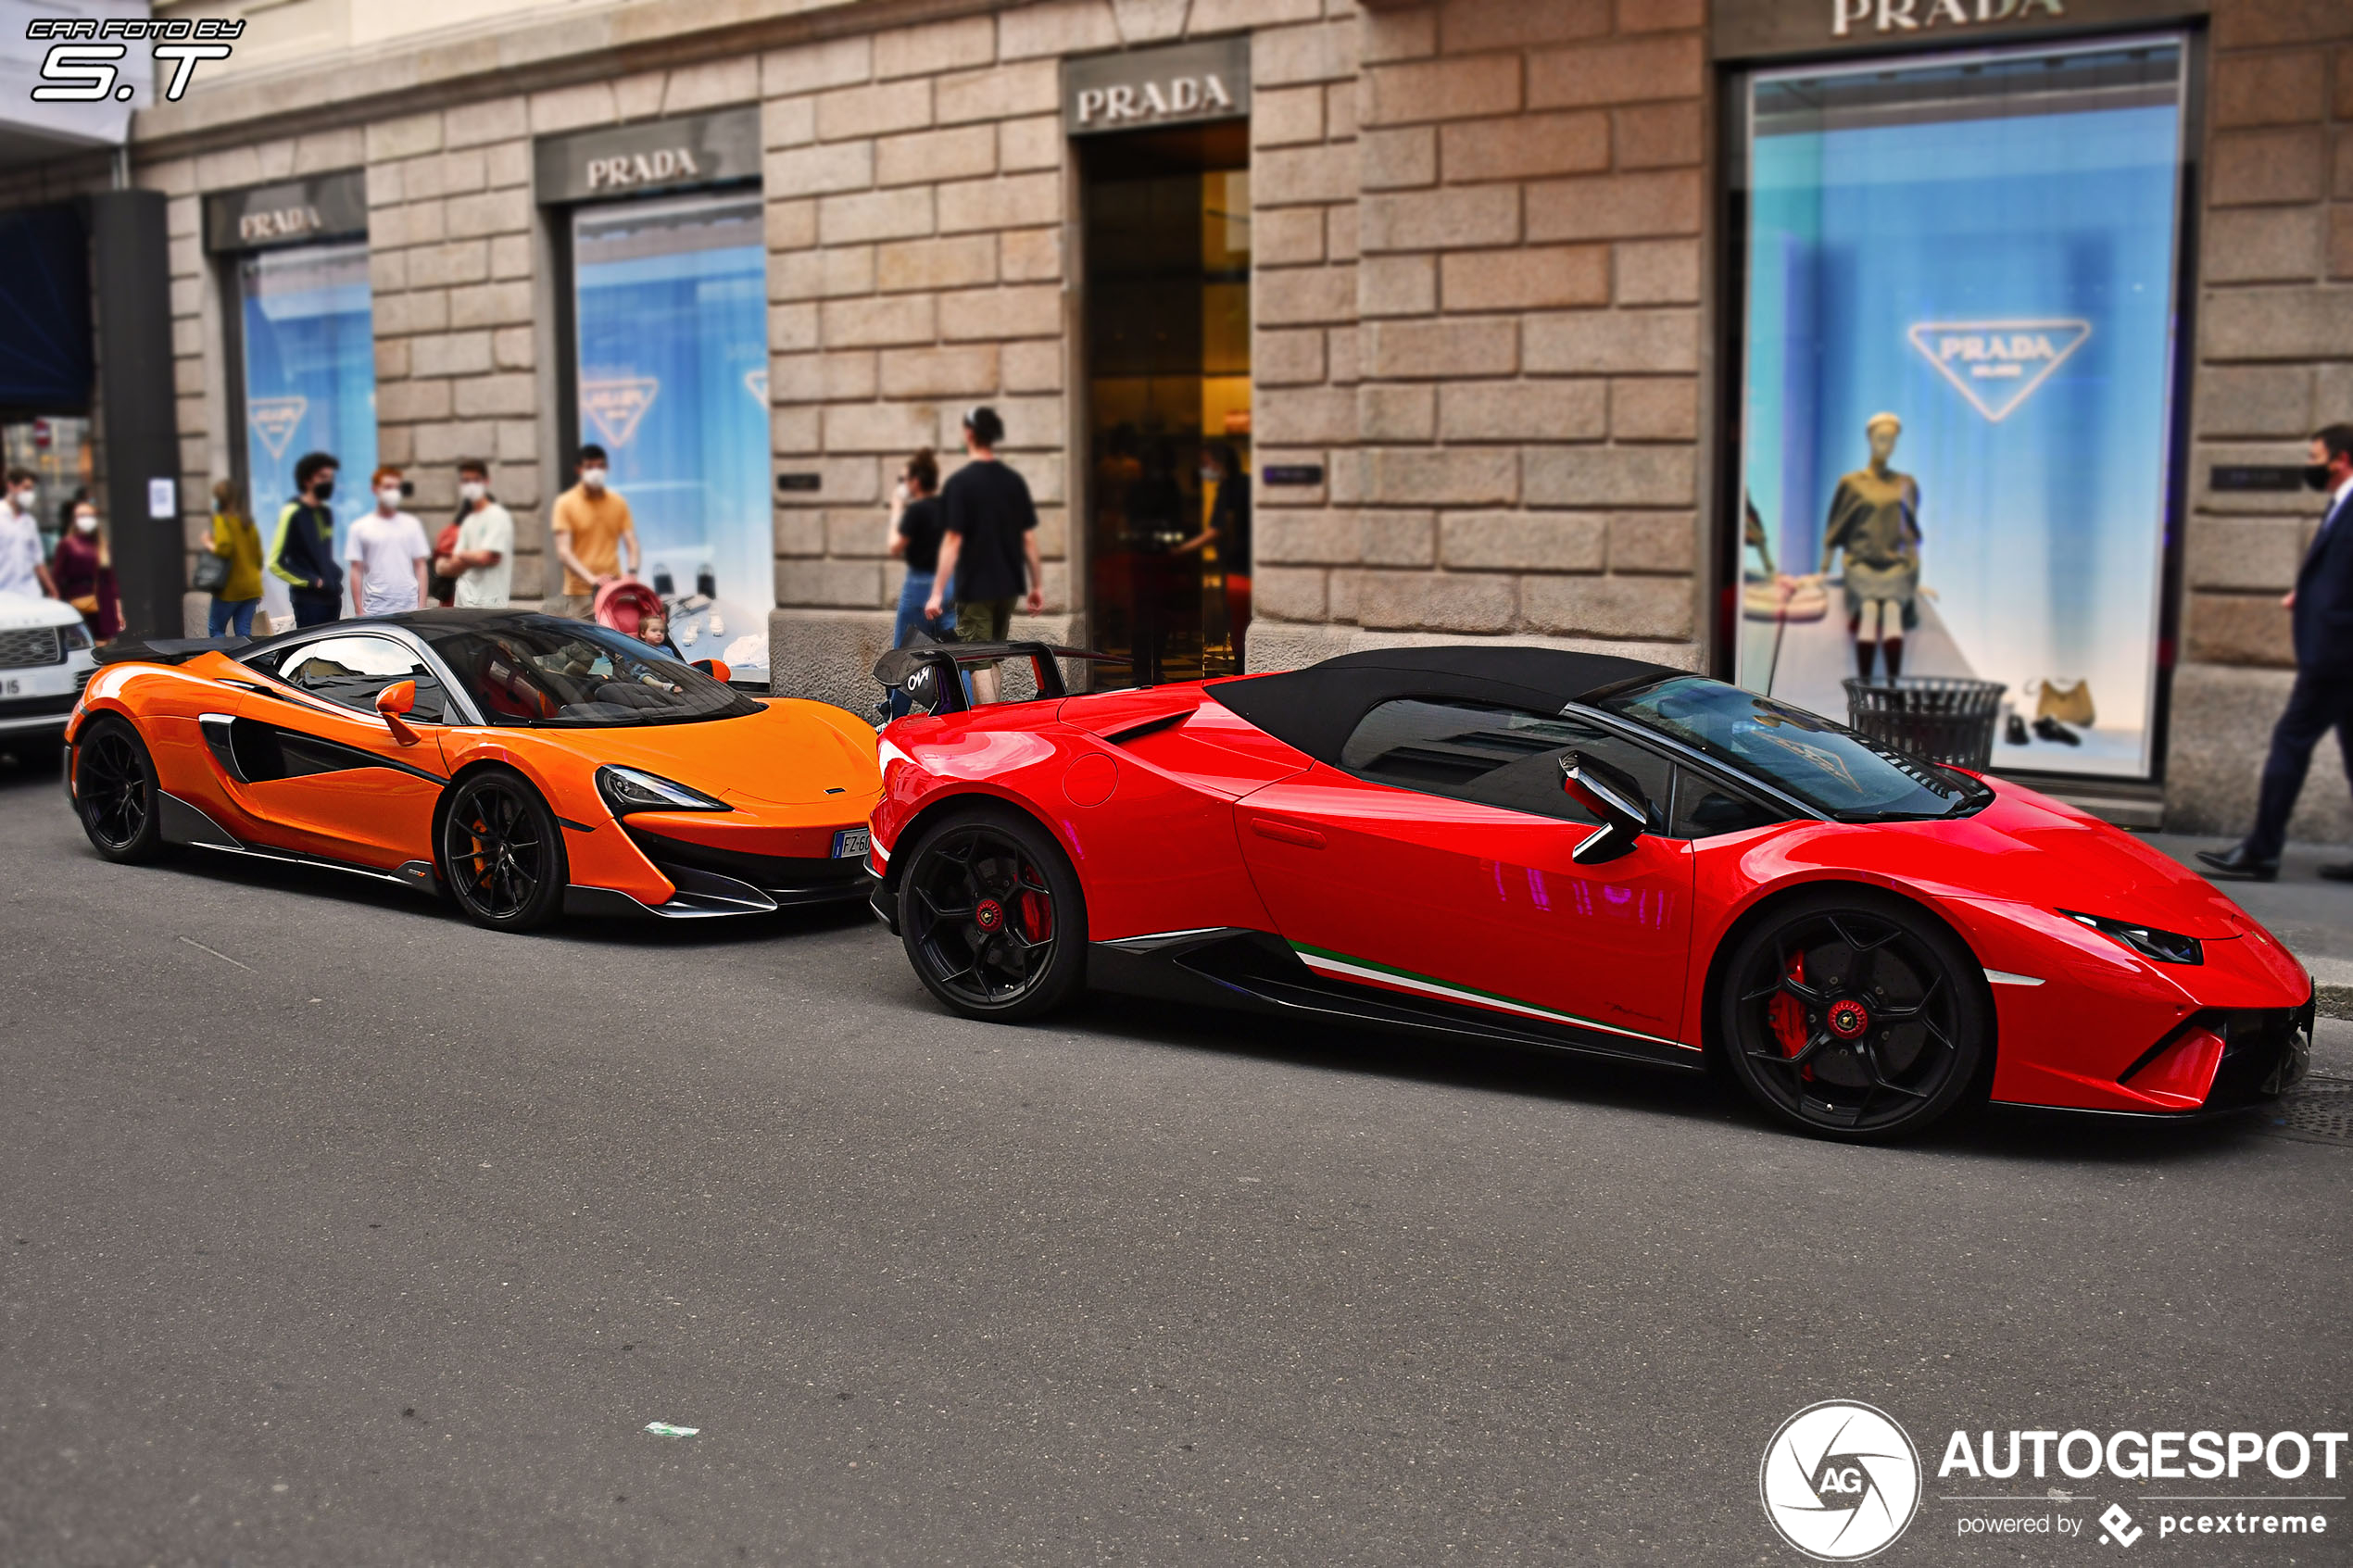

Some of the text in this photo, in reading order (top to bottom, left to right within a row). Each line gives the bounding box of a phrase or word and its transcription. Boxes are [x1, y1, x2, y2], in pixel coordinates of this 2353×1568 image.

[1076, 73, 1231, 123] PRADA
[586, 146, 698, 189] PRADA
[239, 206, 321, 239] PRADA
[1940, 334, 2056, 361] PRADA
